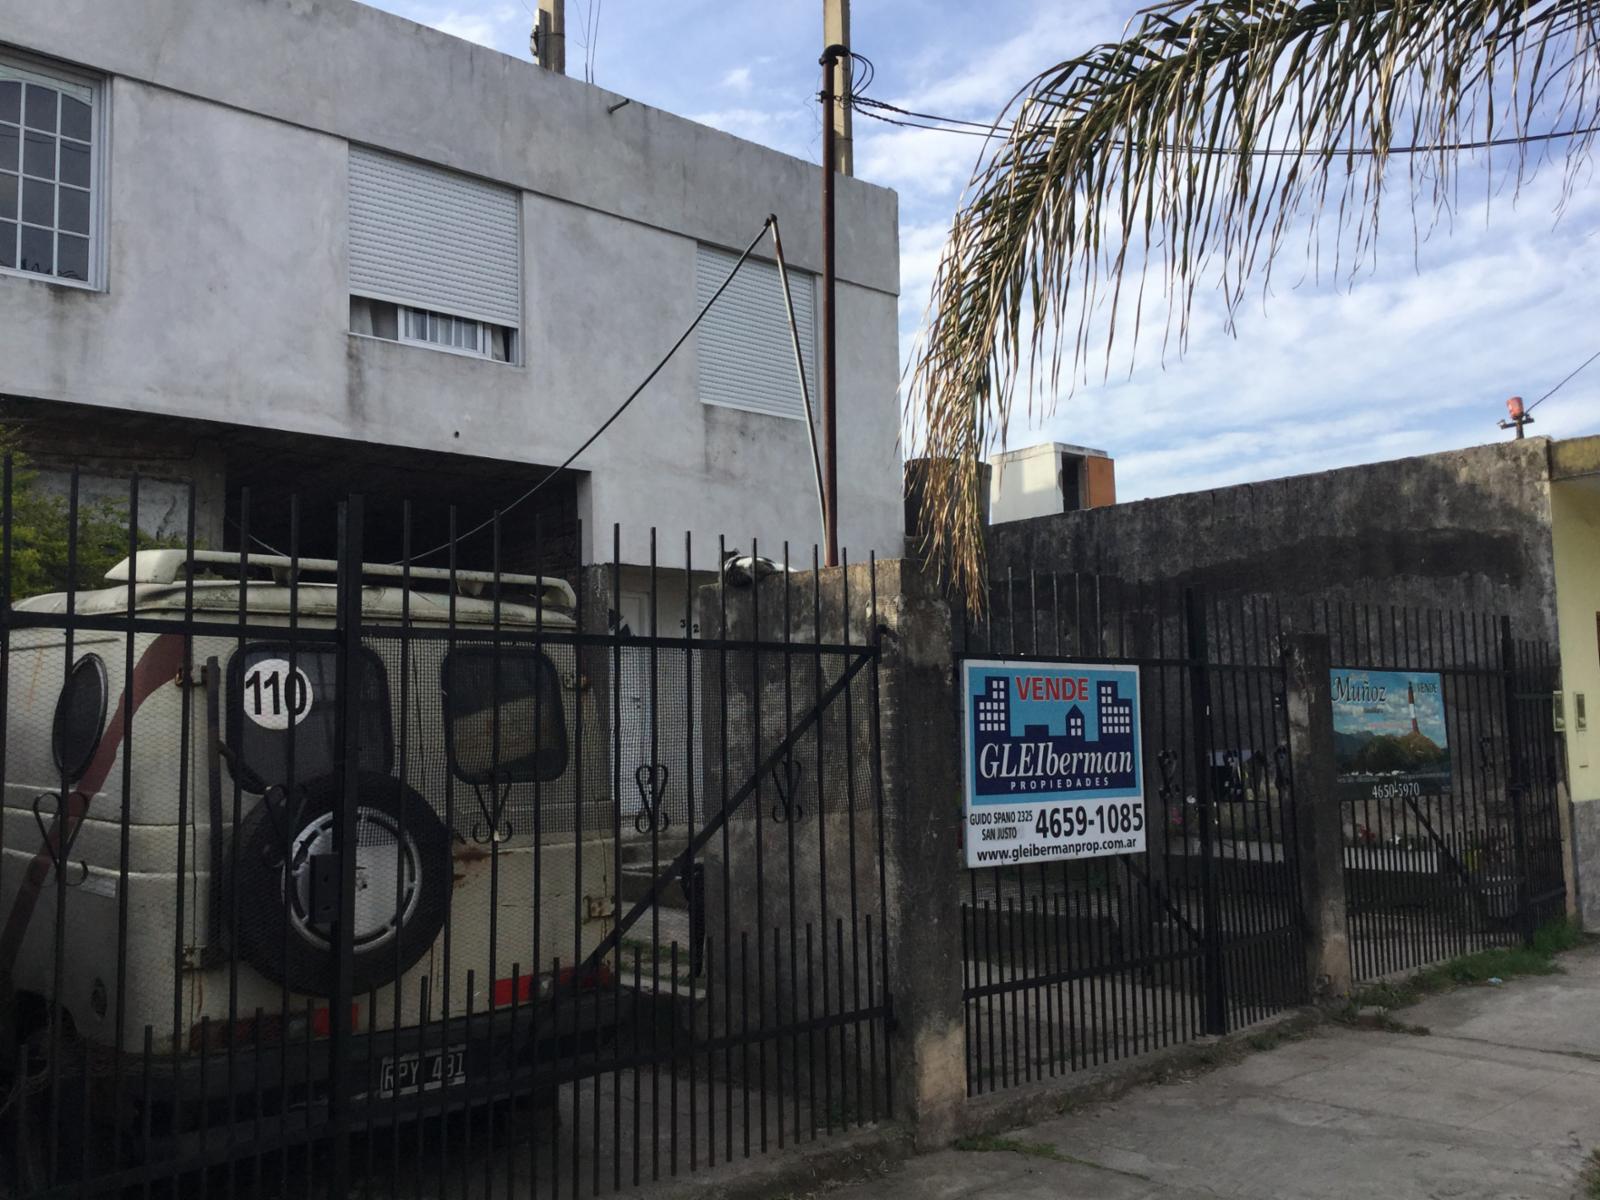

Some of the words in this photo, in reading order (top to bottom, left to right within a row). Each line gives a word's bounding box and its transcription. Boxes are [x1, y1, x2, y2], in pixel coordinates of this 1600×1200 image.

[245, 670, 307, 716] 110
[1016, 676, 1089, 701] VENDE
[1331, 676, 1386, 703] Muñoz
[1010, 776, 1109, 790] PROPIEDADES
[1372, 782, 1420, 799] 4650-5970
[970, 813, 991, 825] GUIDO
[993, 811, 1015, 824] SPANO
[1035, 803, 1143, 838] 4659-1085
[982, 828, 996, 841] SAN
[997, 826, 1017, 840] JUSTO
[977, 838, 1136, 861] www.gleibermanprop.com.ar
